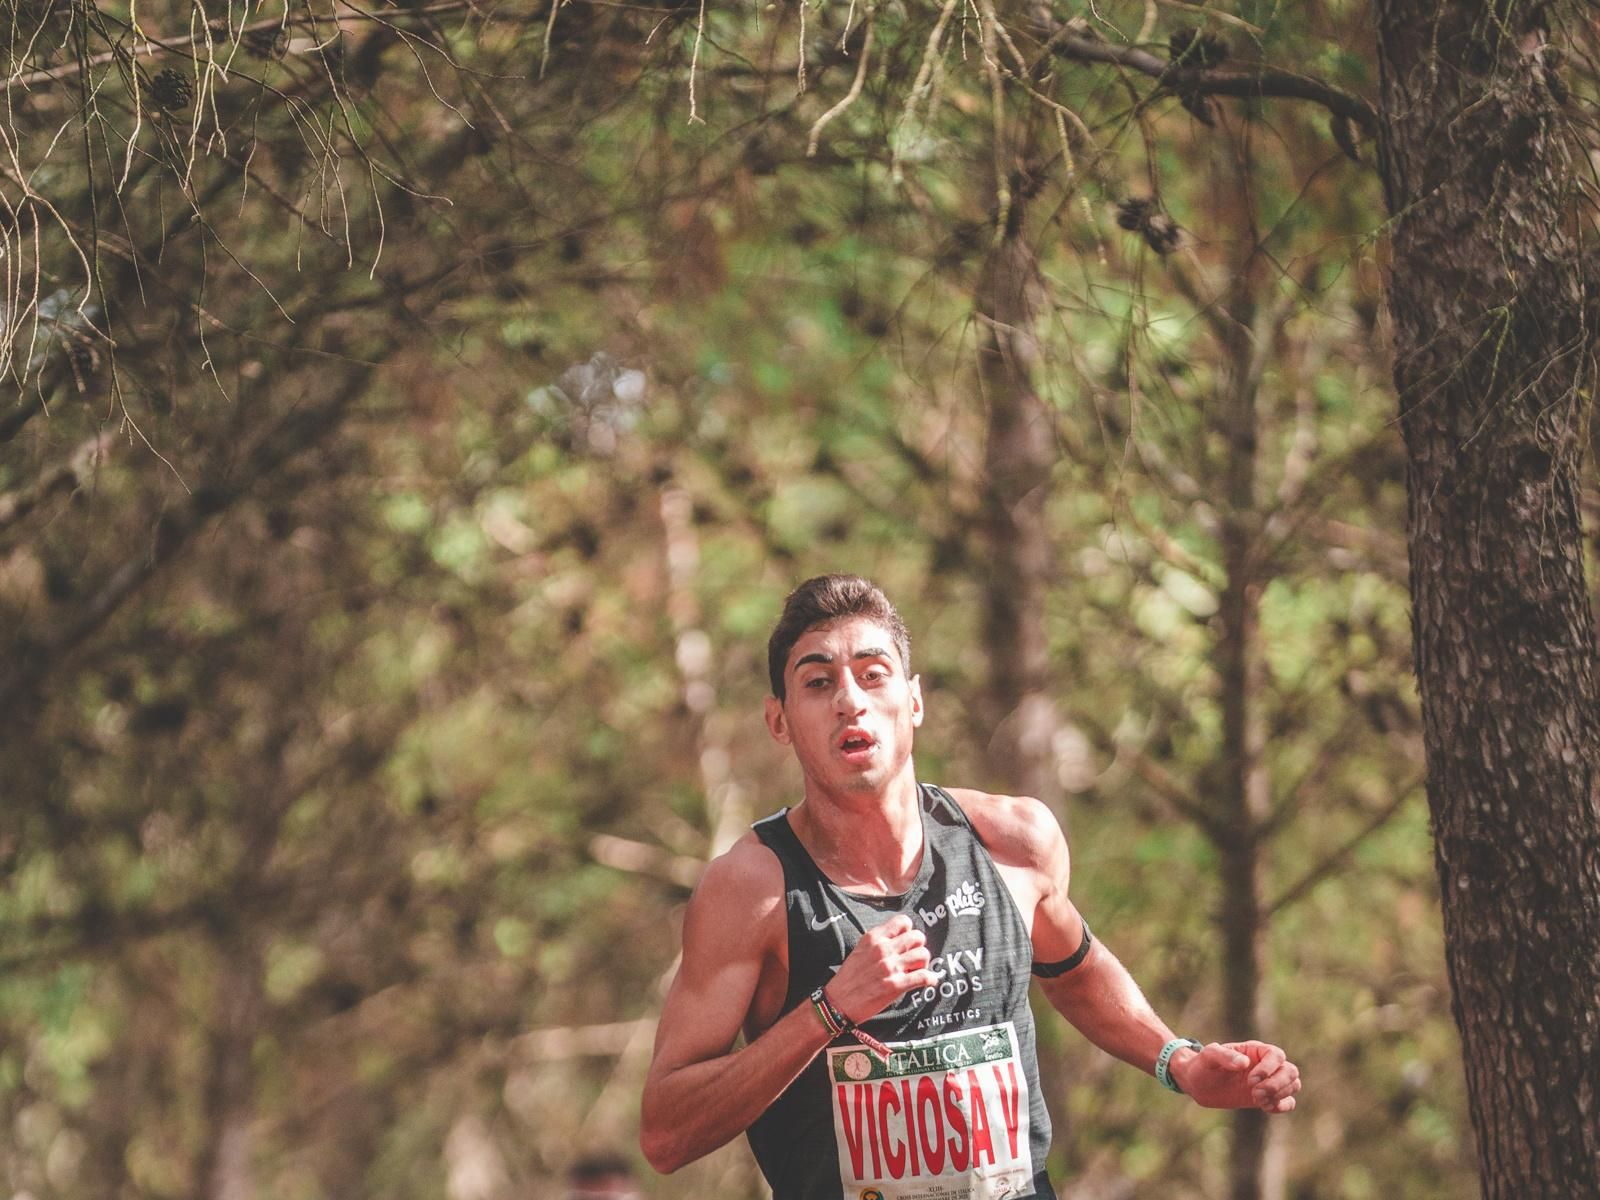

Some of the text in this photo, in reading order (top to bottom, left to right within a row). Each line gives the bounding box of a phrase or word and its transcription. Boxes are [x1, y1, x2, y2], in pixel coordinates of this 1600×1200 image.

[918, 904, 947, 927] be
[911, 976, 983, 1008] FOODS
[917, 1008, 981, 1030] ATHLETICS
[837, 1062, 1020, 1181] VICIOSA V
